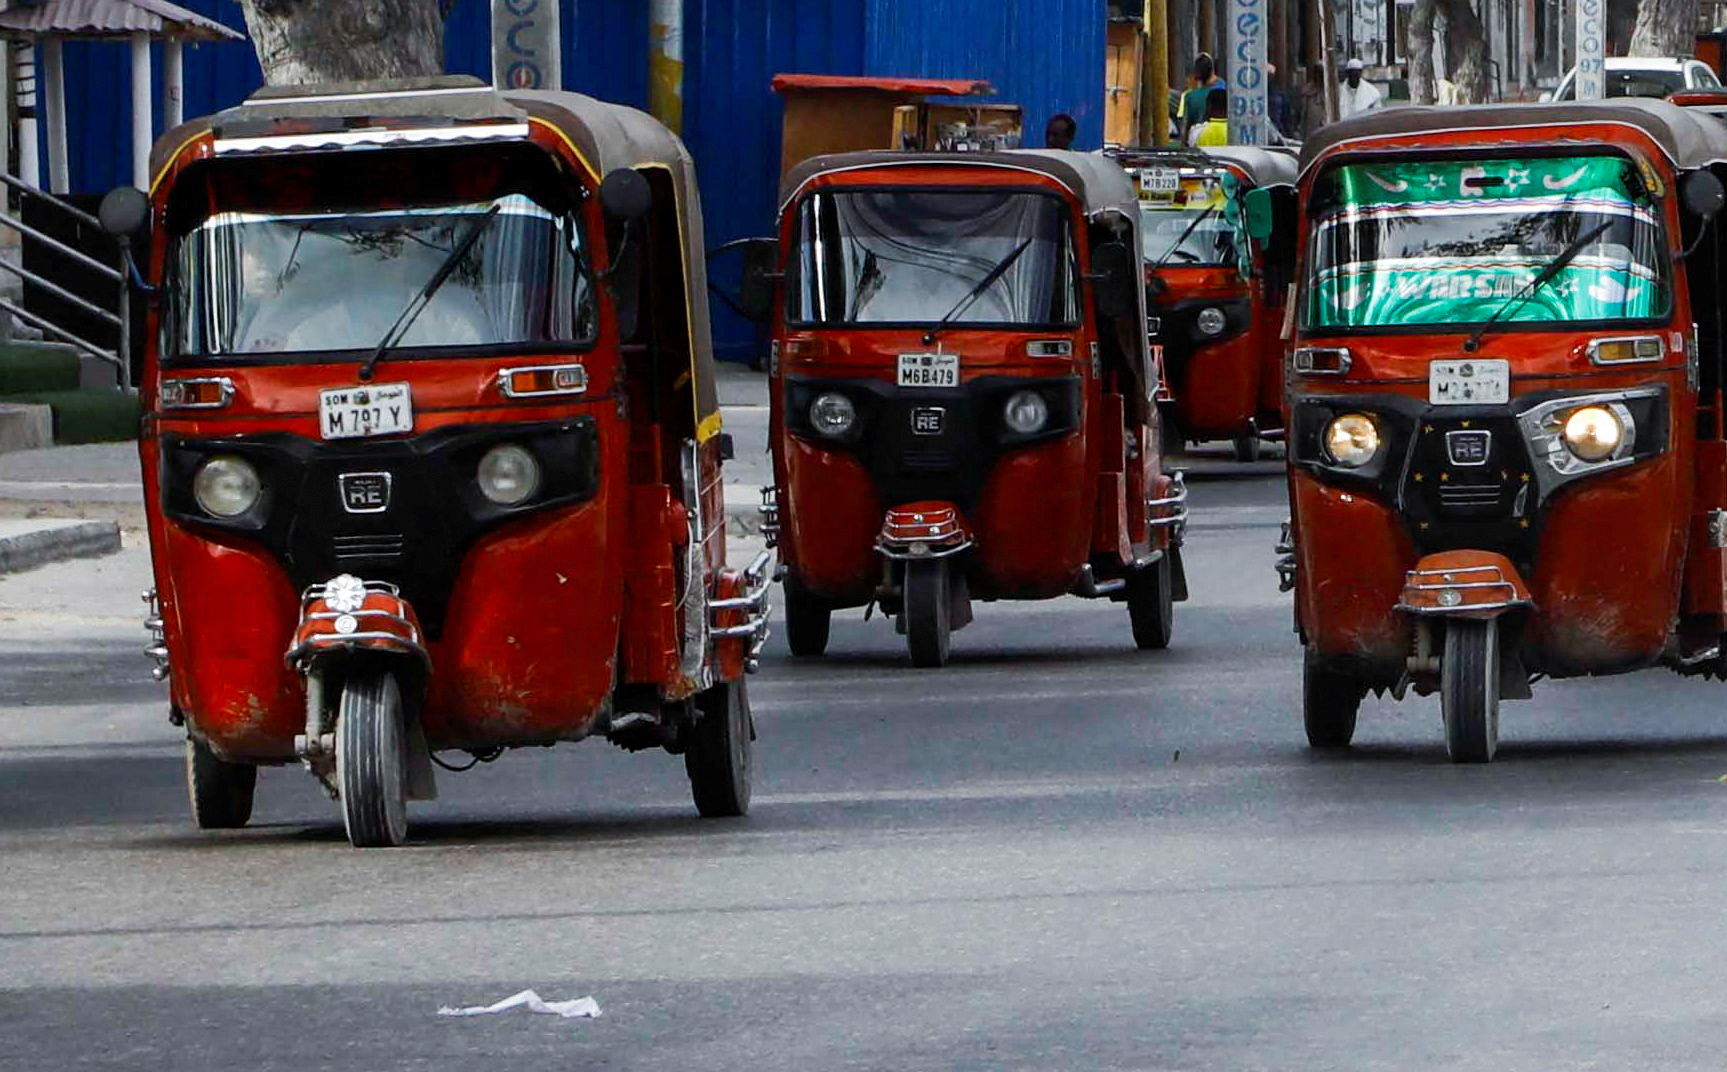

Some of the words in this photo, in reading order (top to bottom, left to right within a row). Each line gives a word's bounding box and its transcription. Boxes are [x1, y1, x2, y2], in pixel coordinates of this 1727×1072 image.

[325, 393, 348, 406] SOM
[329, 411, 345, 433] M
[390, 406, 401, 427] Y
[917, 416, 940, 430] RE
[350, 485, 382, 504] RE
